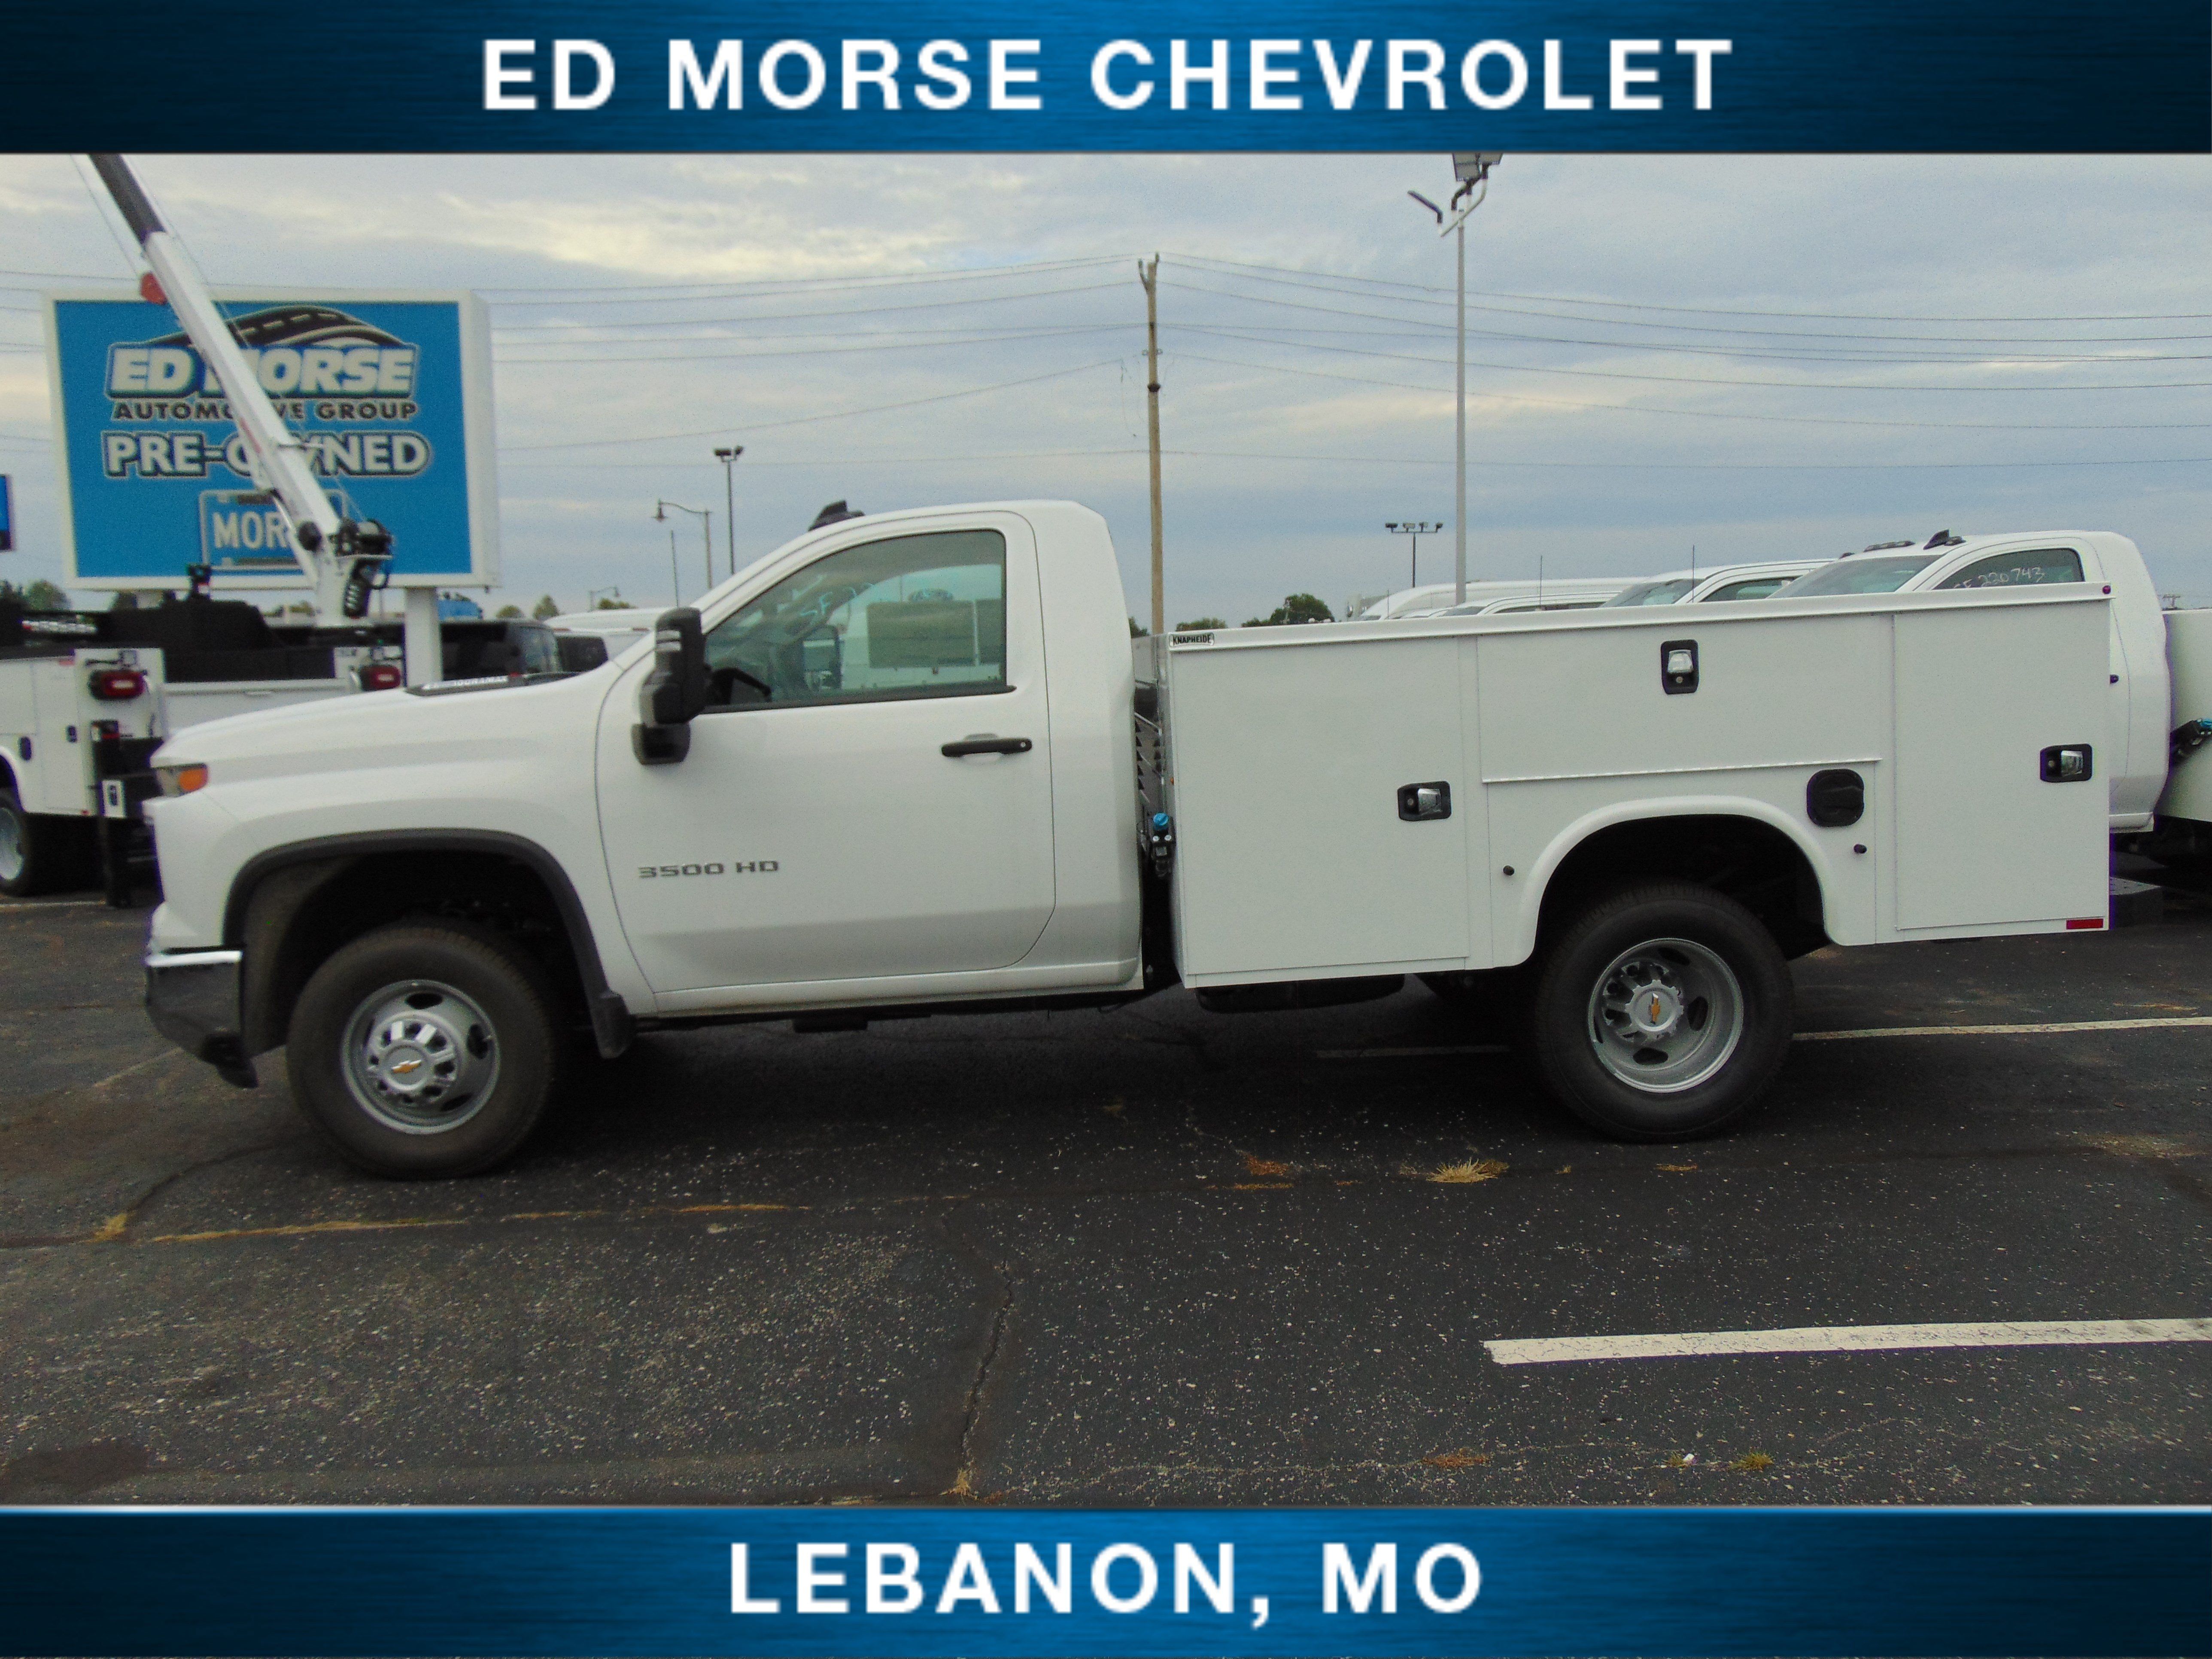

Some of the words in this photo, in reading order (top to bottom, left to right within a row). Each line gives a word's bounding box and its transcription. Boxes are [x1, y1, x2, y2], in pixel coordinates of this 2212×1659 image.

[110, 347, 193, 392] ED
[315, 401, 417, 420] GROUP
[638, 863, 724, 878] 3500
[735, 860, 778, 872] HD
